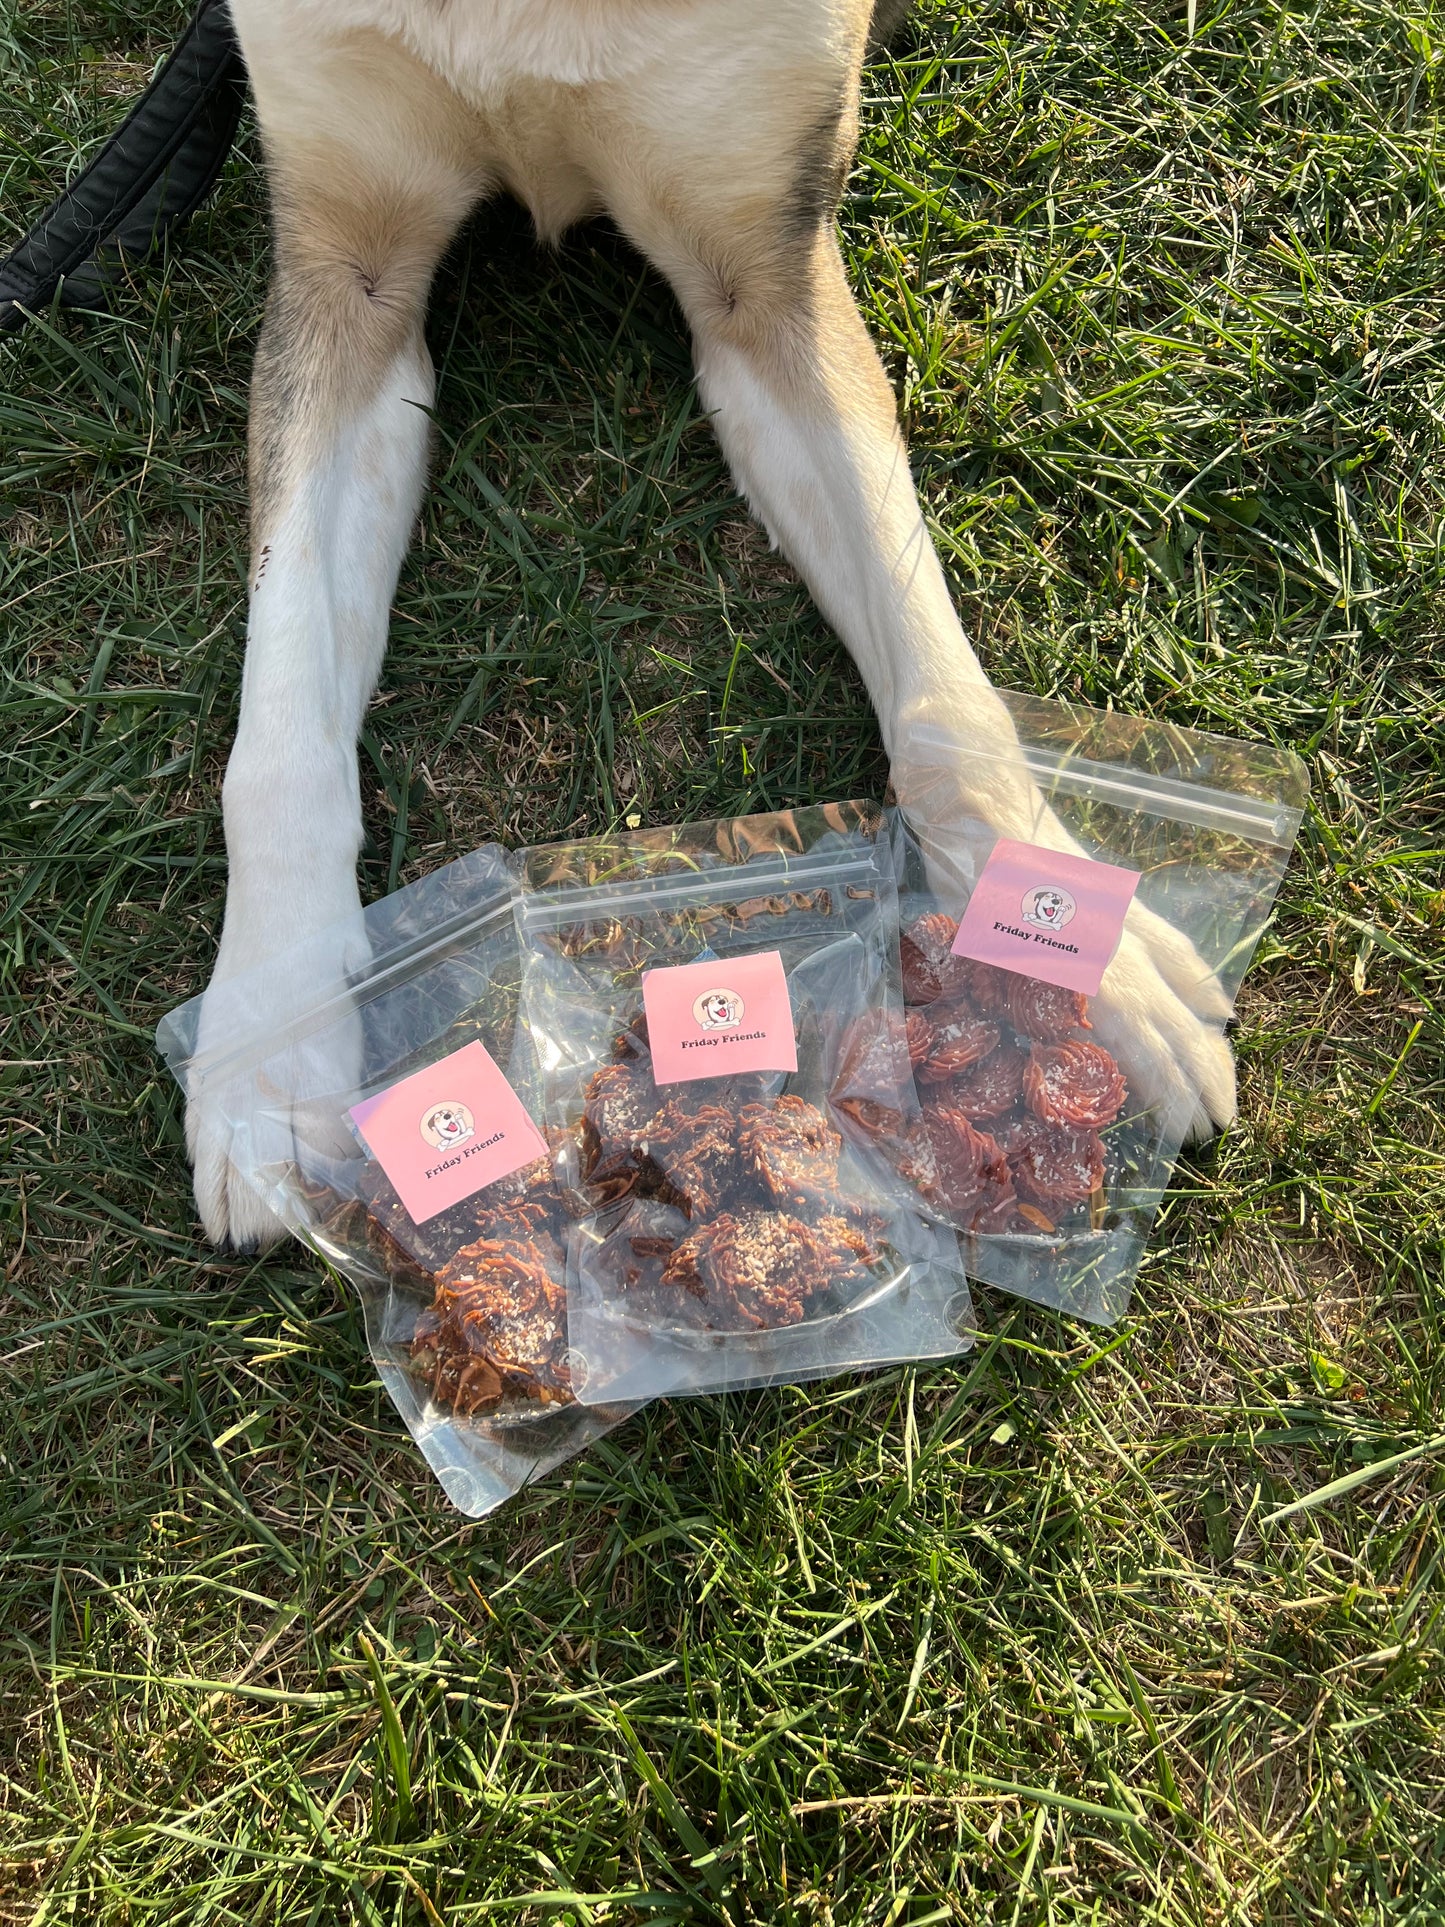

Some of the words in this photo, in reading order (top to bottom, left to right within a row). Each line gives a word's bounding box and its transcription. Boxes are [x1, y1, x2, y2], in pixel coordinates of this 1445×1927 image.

[993, 922, 1032, 940] Friday
[1033, 933, 1079, 954] Friends
[681, 1038, 719, 1049] Friday
[722, 1031, 766, 1043] Friends
[424, 1155, 462, 1179] Friday
[462, 1131, 505, 1158] Friends
